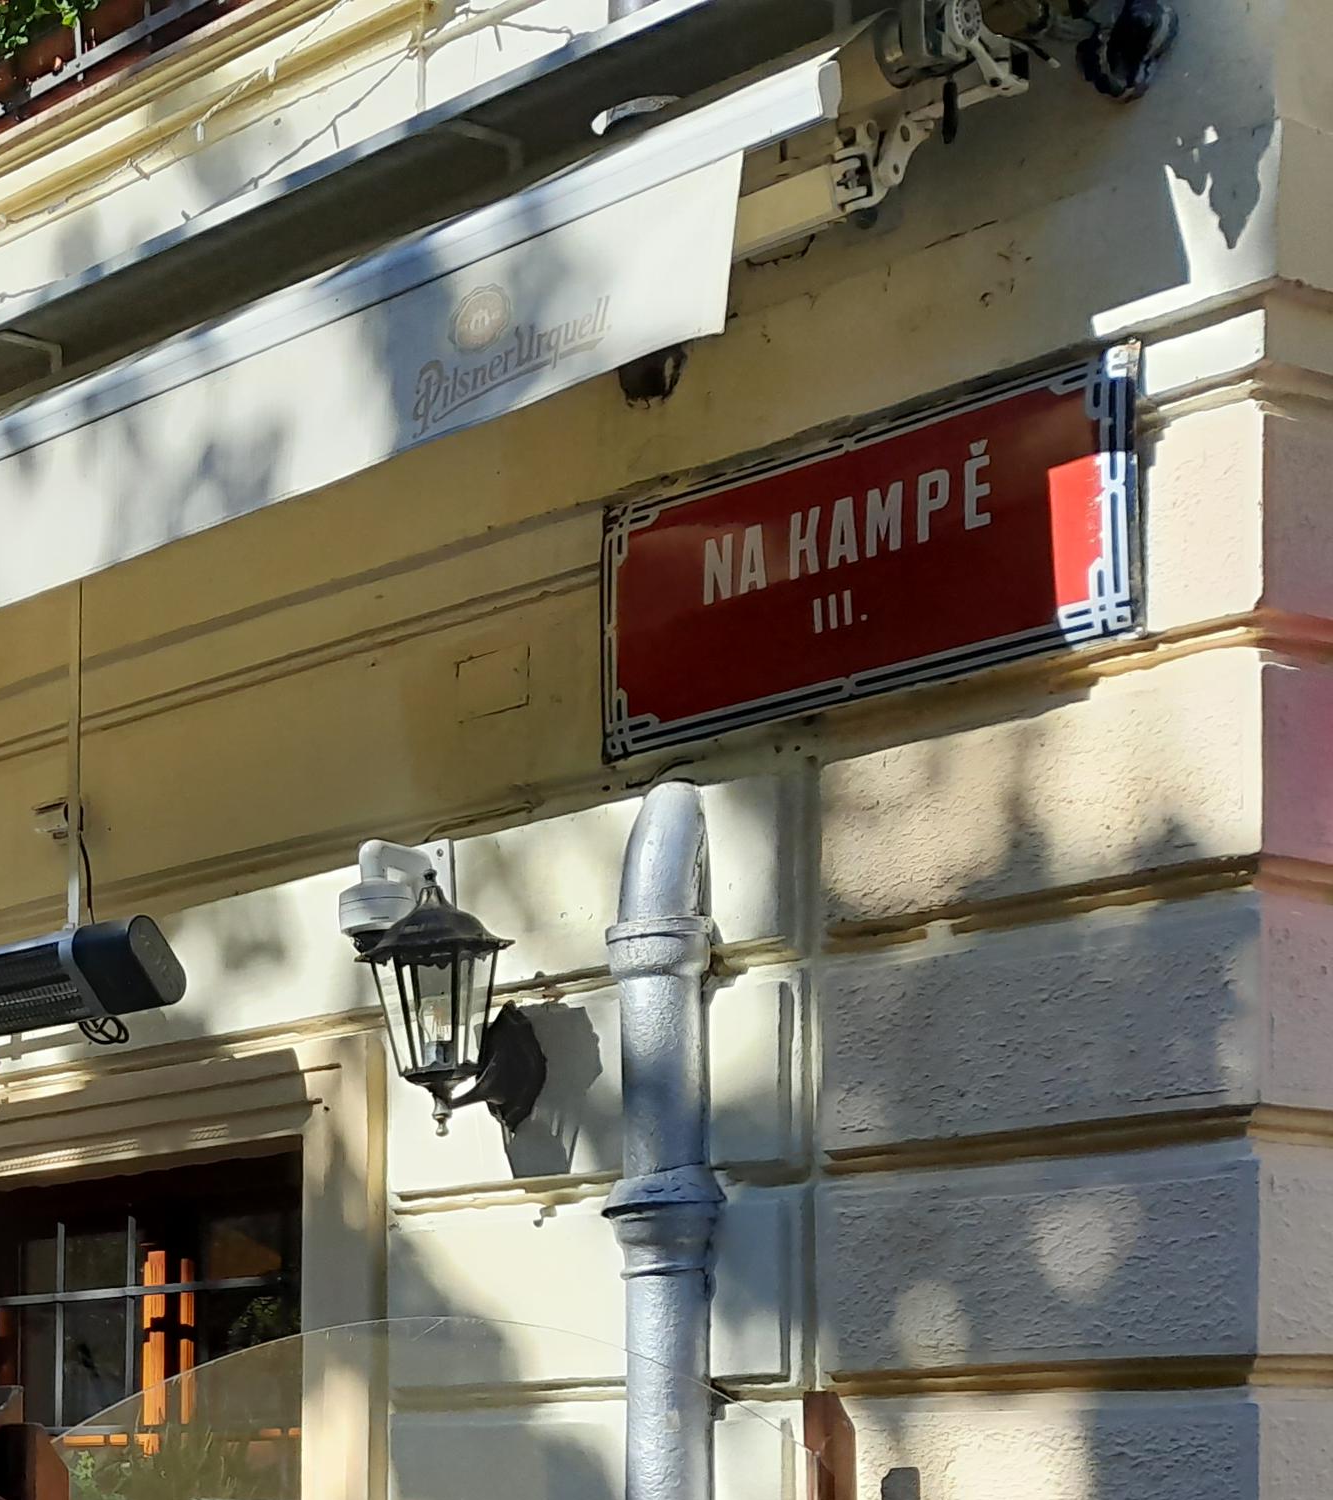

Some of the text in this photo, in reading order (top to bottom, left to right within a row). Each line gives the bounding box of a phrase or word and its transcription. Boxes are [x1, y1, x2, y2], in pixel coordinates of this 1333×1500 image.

[412, 347, 515, 438] Pilsner
[703, 439, 993, 606] NA KAMPĚ
[812, 589, 868, 633] III.
